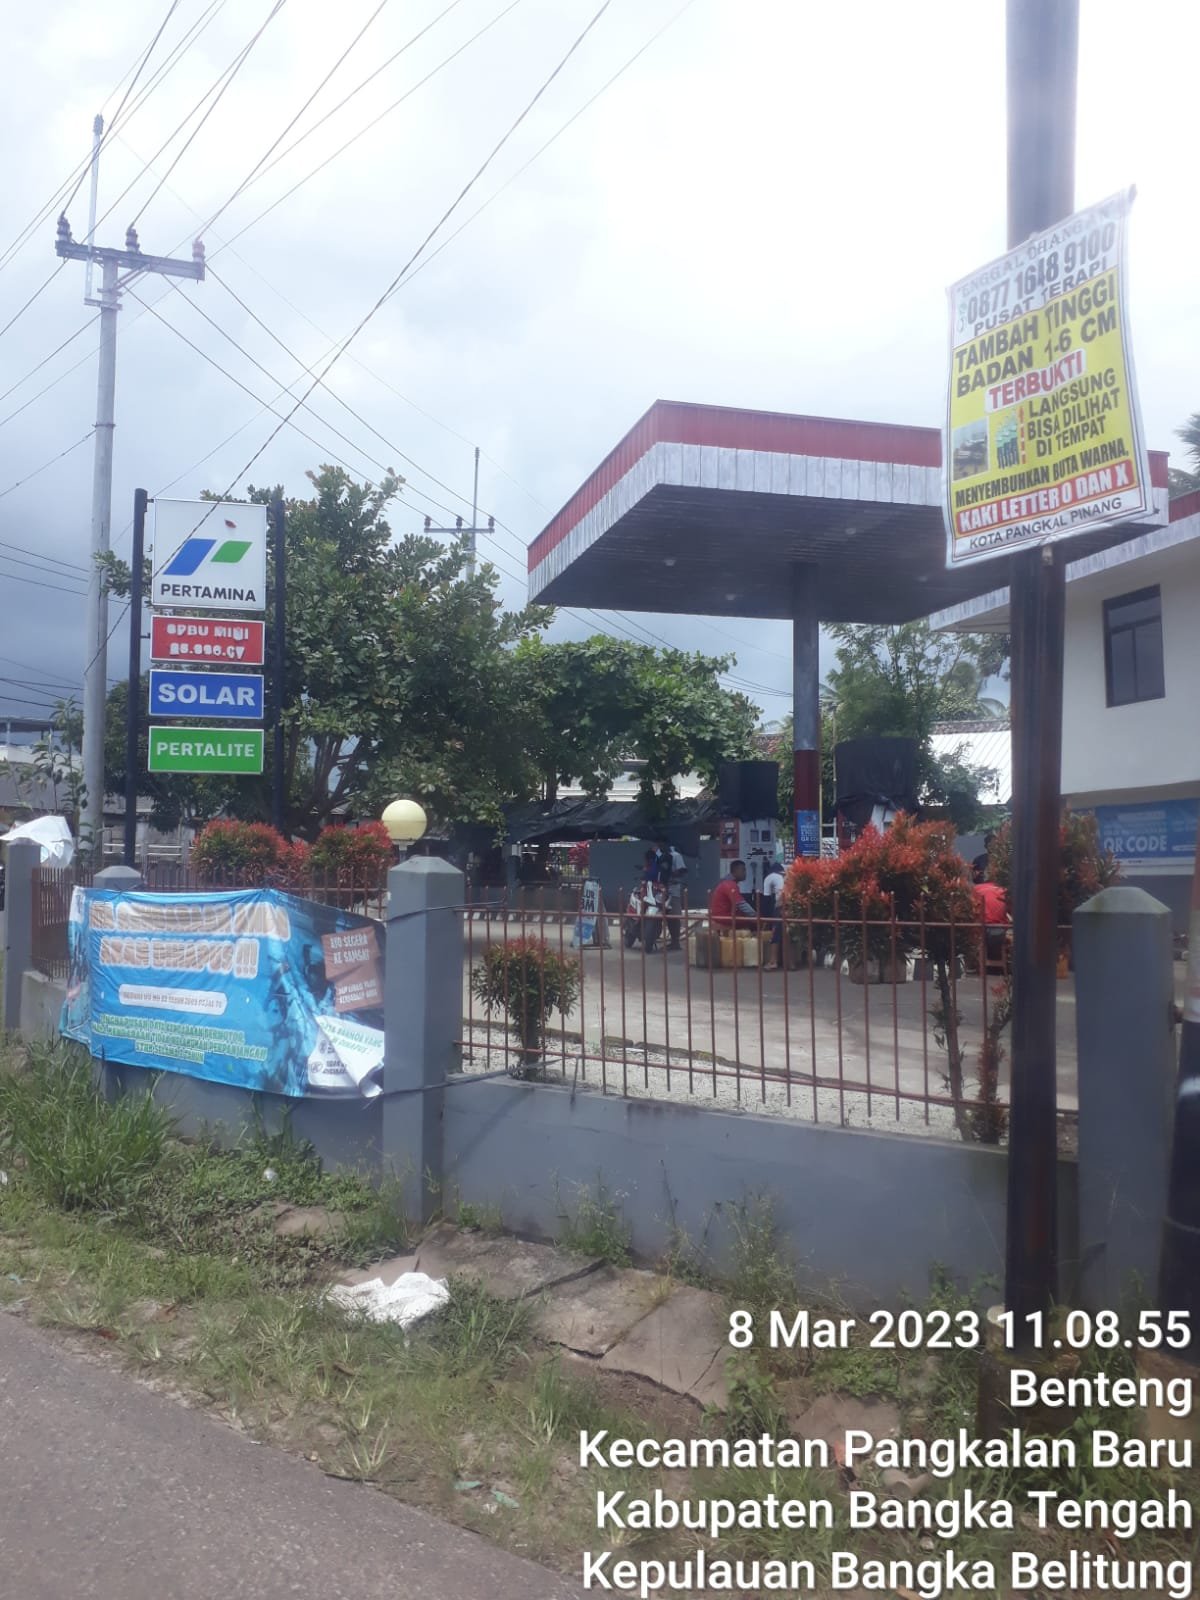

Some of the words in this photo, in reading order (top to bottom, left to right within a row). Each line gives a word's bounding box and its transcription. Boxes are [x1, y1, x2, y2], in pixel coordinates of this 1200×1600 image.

[967, 280, 1010, 325] 0877
[1015, 251, 1059, 299] 1648
[1064, 222, 1116, 273] 9100
[974, 296, 1035, 337] PUSAT
[1041, 256, 1107, 302] TERAPI
[955, 315, 1039, 373] TAMBAH
[1045, 274, 1115, 333] TINGGI
[956, 346, 1033, 398] BADAN
[1044, 328, 1072, 363] 1-6
[1081, 305, 1117, 343] CM
[988, 349, 1084, 410] TERBUKTI
[1027, 367, 1116, 419] LANGSUNG
[1027, 414, 1060, 441] BISA
[1063, 387, 1121, 427] DILIHAT
[1036, 438, 1053, 457] DI
[1056, 415, 1107, 451] TEMPAT
[955, 465, 1050, 508] MENYEMBUHKAN
[1053, 453, 1078, 481] BUTA
[959, 504, 999, 532] KAKI
[1000, 486, 1060, 520] LETTER
[1076, 469, 1113, 501] DAN
[1115, 463, 1129, 487] X
[969, 529, 1004, 550] KOTA
[1006, 515, 1068, 541] PANGKAL
[1071, 496, 1123, 521] PINANG
[160, 583, 256, 602] PERTAMINA
[158, 683, 256, 706] SOLAR
[156, 742, 256, 758] PERTALITE
[1103, 836, 1124, 853] QR
[1126, 835, 1168, 853] CODE
